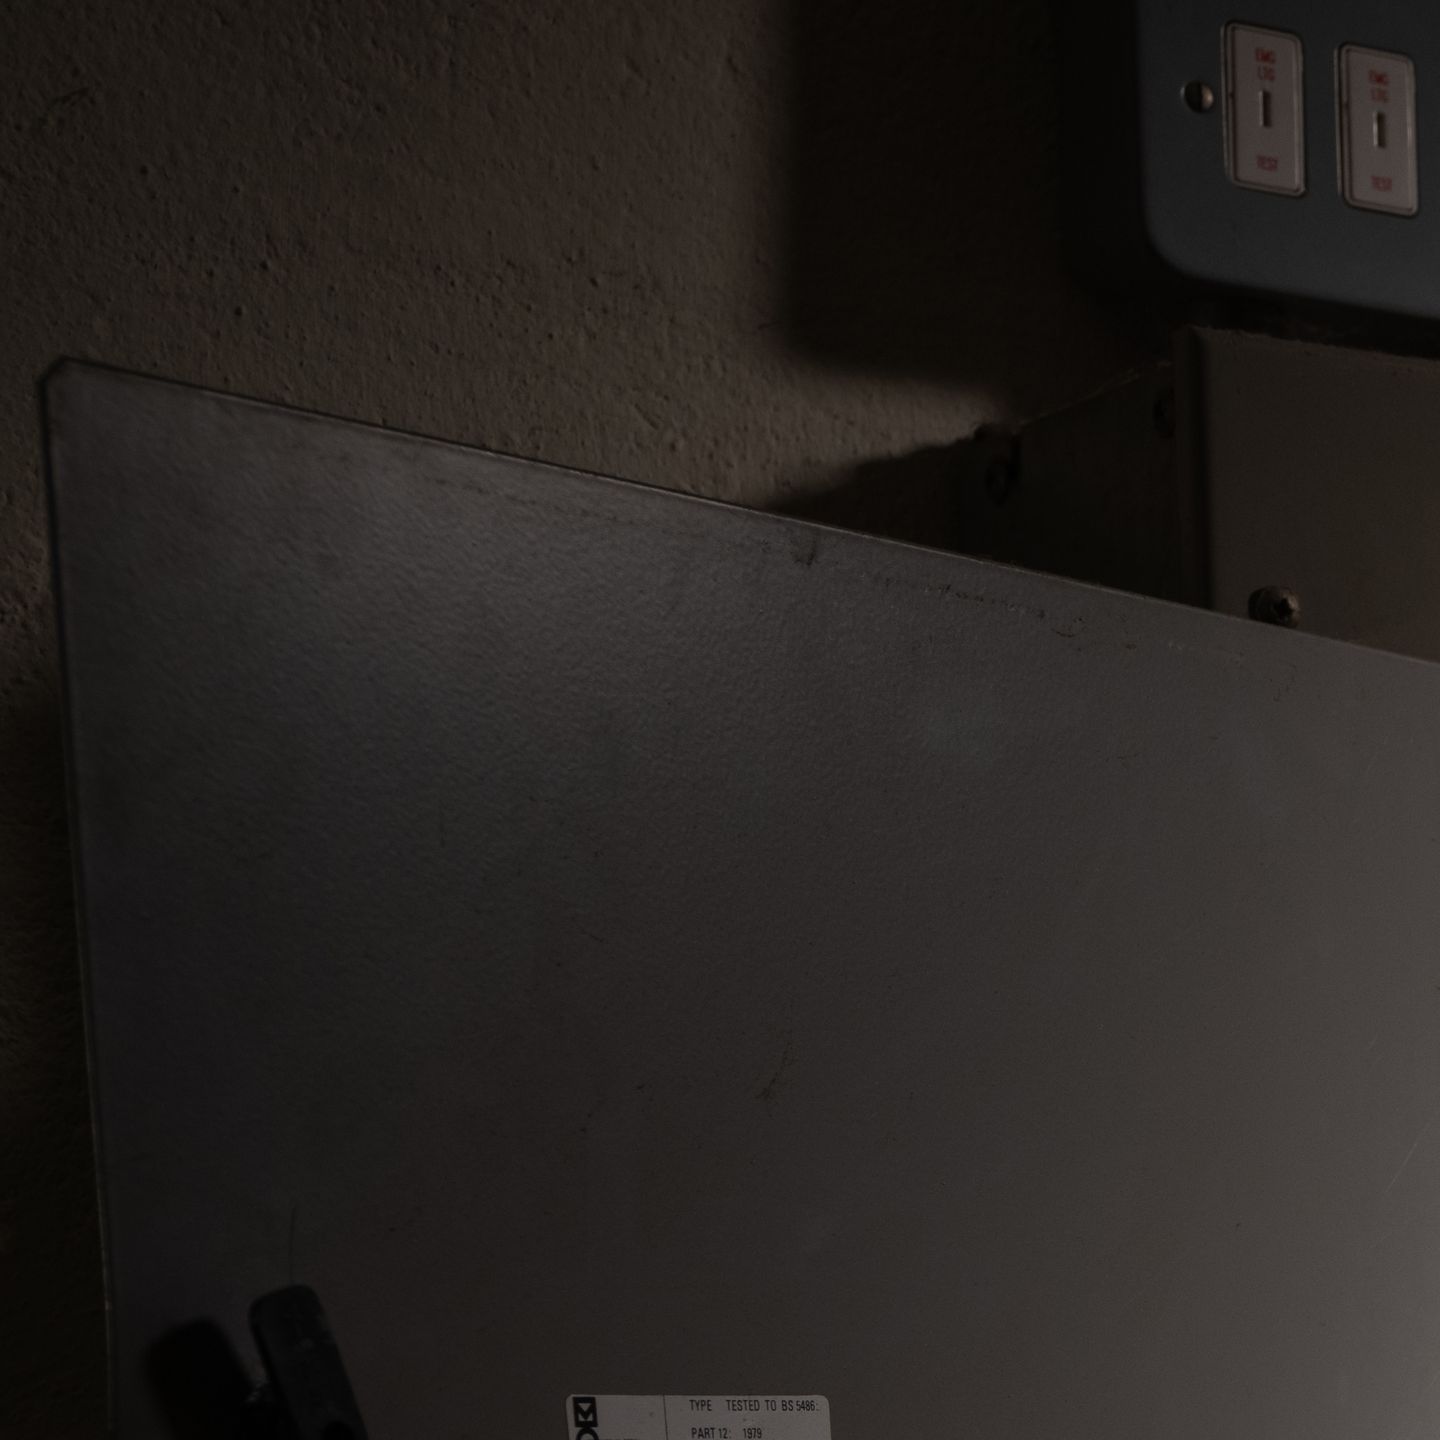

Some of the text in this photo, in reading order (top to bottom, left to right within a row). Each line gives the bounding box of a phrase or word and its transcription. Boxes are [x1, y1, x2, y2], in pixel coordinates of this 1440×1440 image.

[688, 1398, 713, 1412] TYPE
[724, 1398, 761, 1412] TESTED
[763, 1398, 777, 1412] TO
[780, 1398, 794, 1412] BS
[690, 1425, 716, 1439] PART
[741, 1426, 763, 1440] 1979
